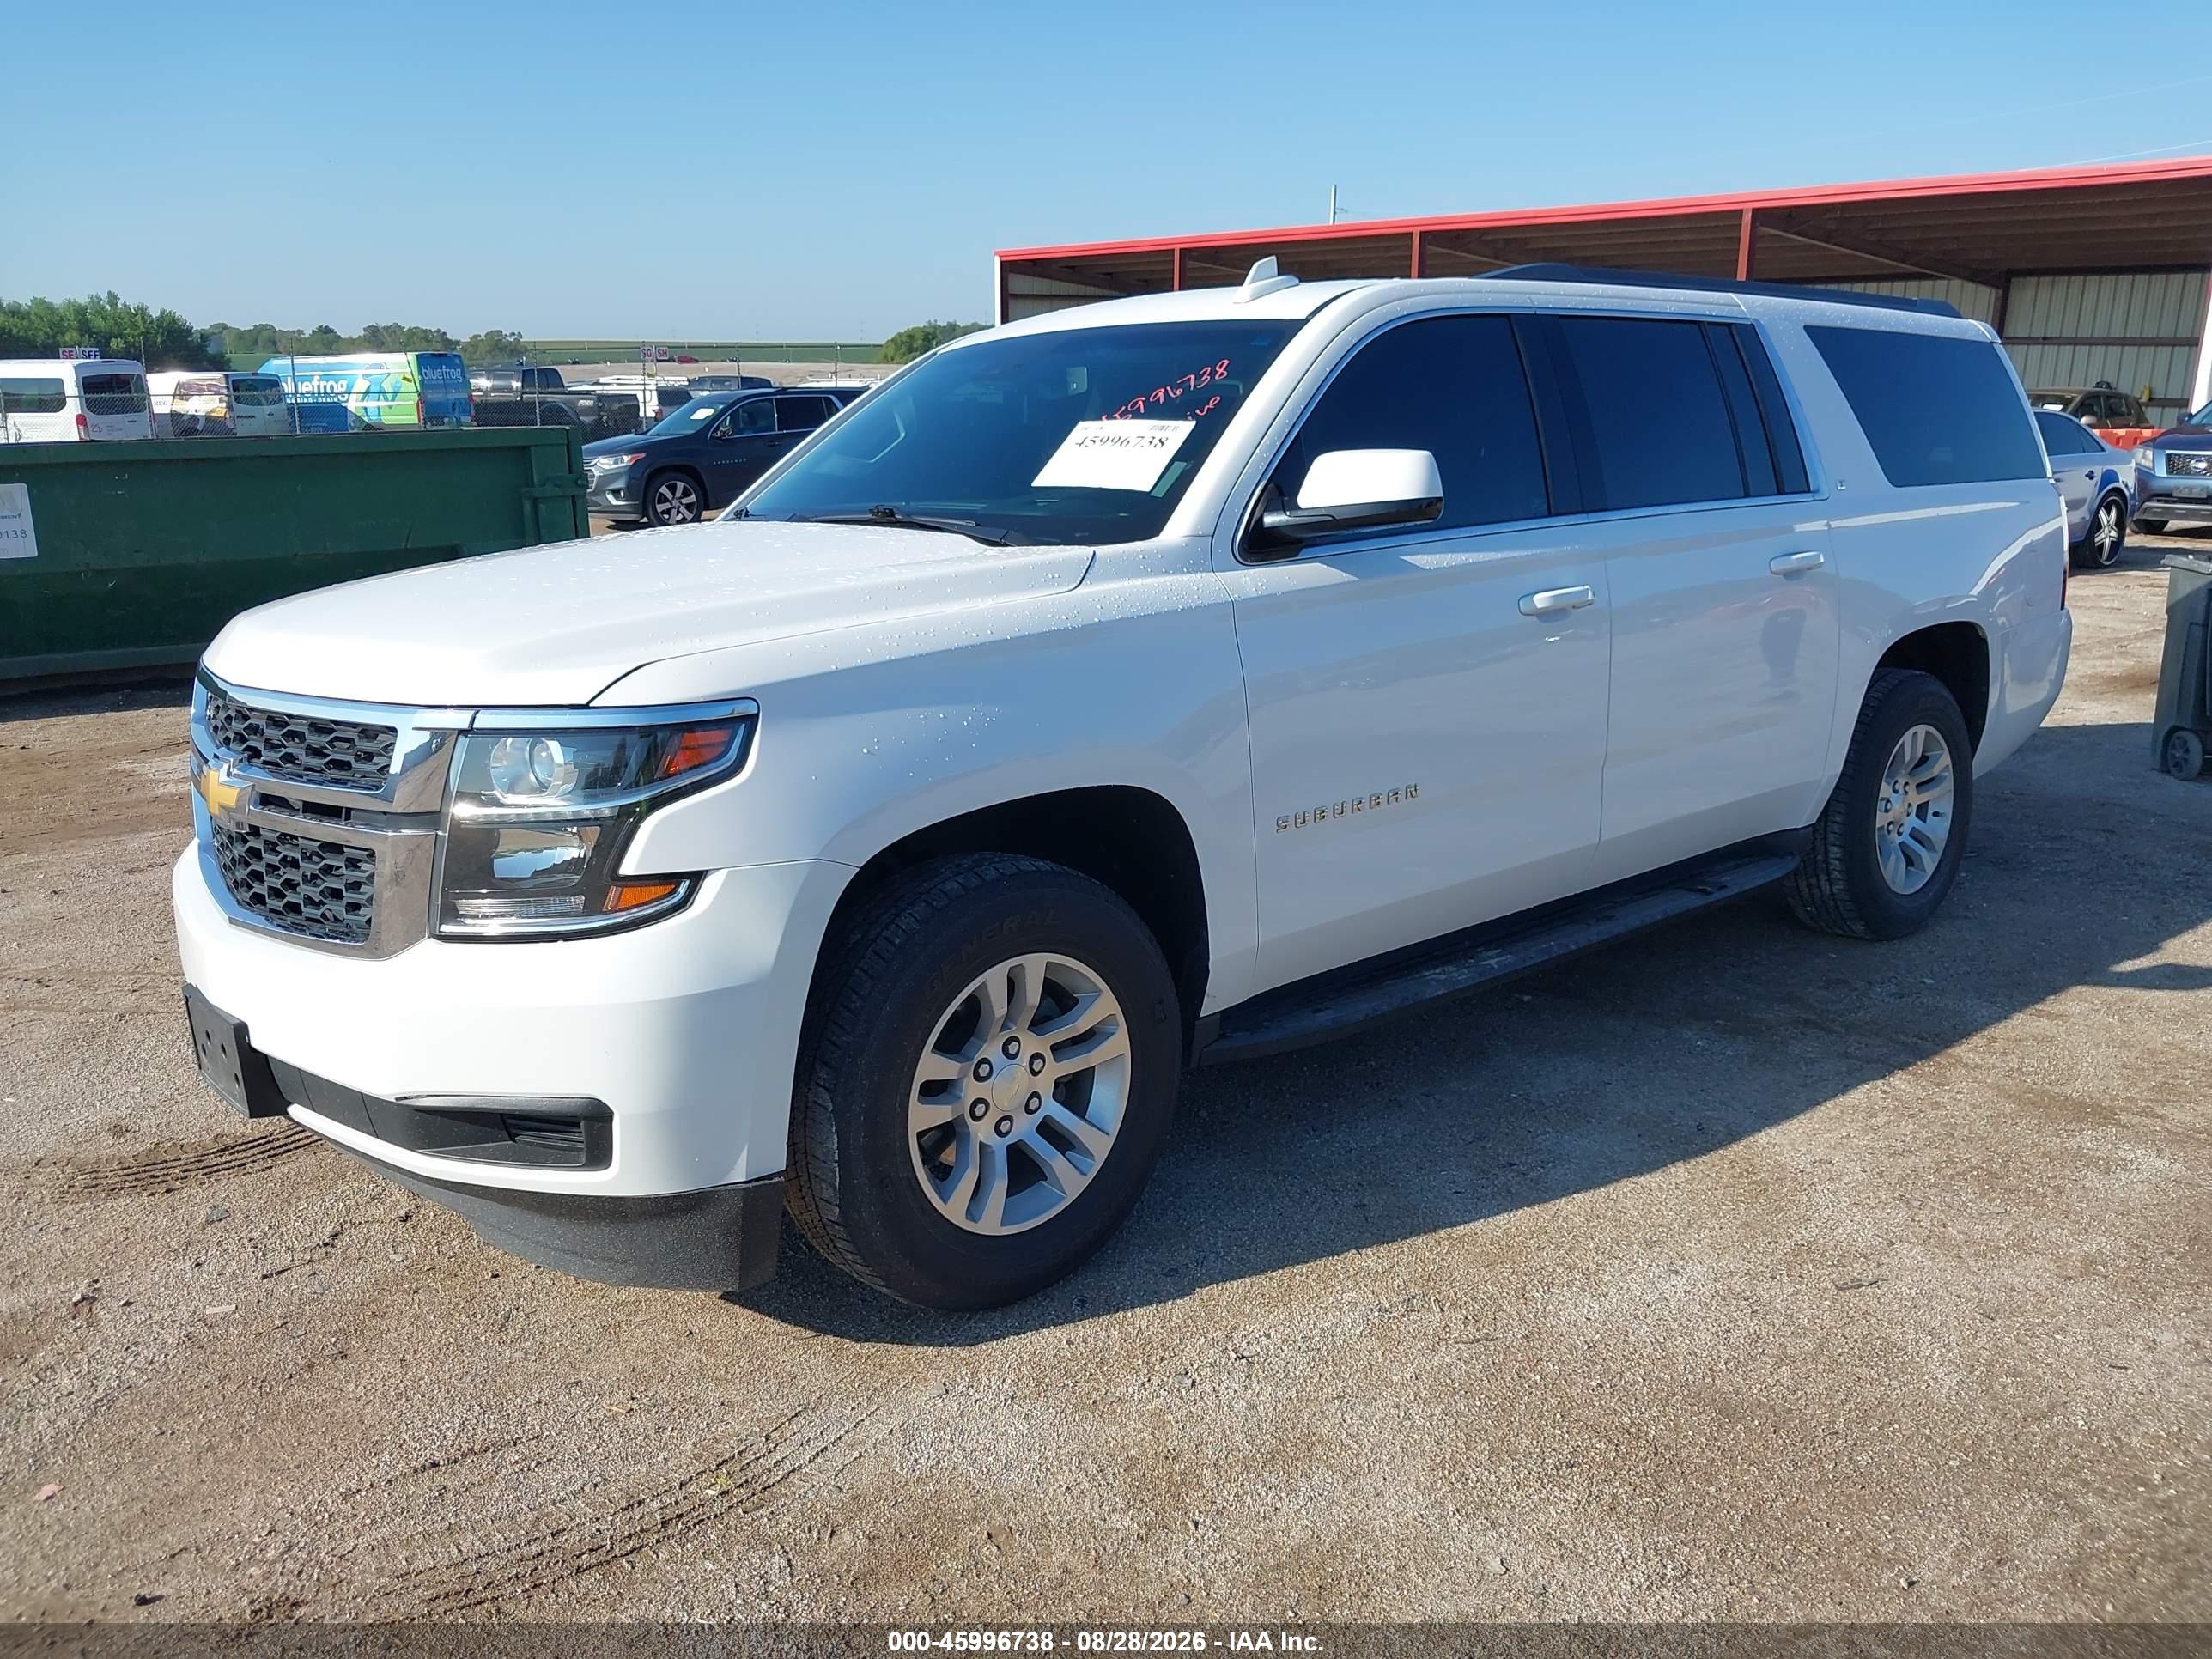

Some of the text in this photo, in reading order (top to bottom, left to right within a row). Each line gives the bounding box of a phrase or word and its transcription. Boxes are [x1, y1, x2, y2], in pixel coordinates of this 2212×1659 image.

[421, 366, 462, 383] bluefrog
[1074, 435, 1169, 448] 45996738
[1276, 783, 1419, 834] SUBURBAN
